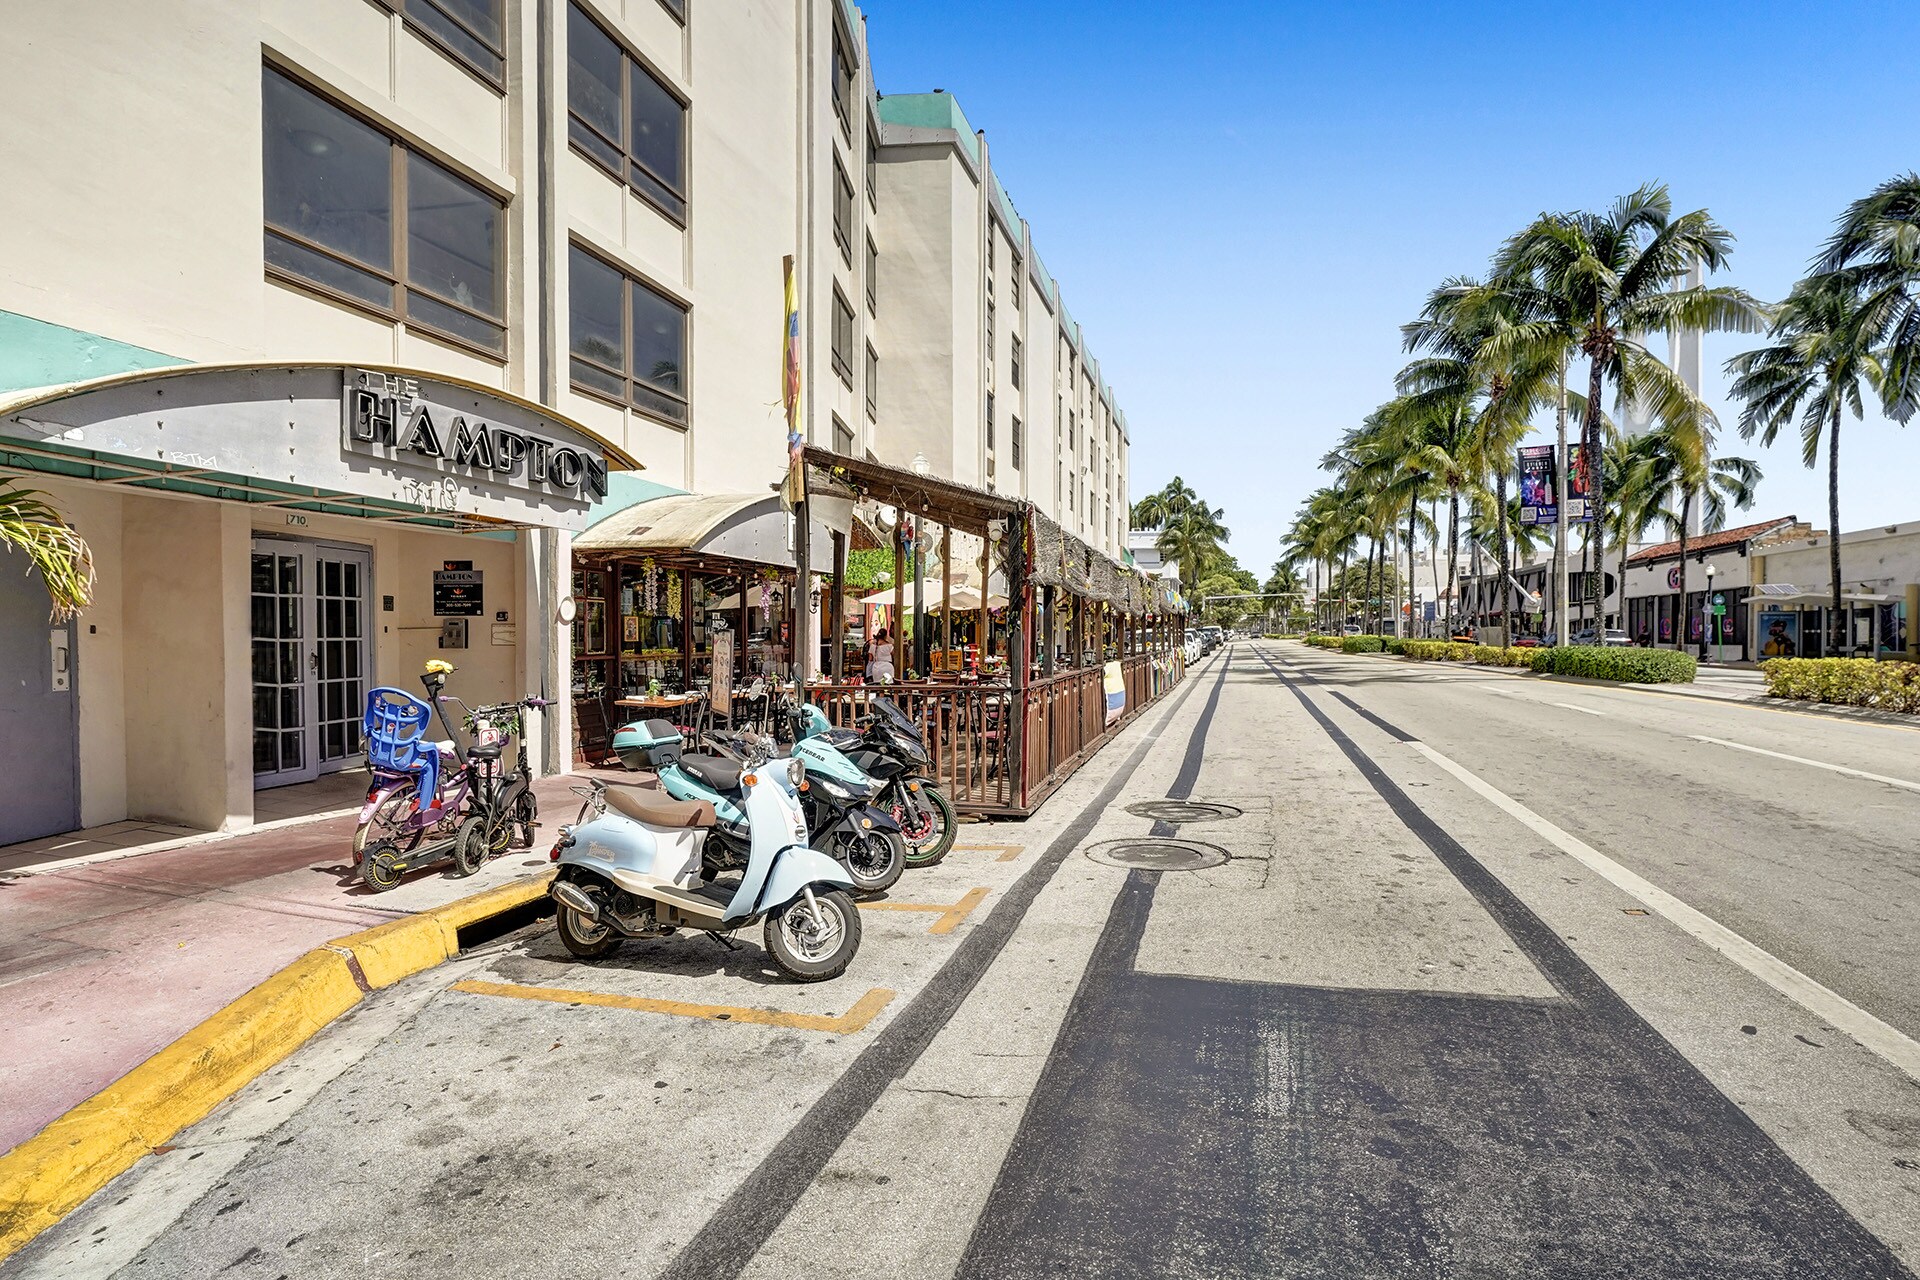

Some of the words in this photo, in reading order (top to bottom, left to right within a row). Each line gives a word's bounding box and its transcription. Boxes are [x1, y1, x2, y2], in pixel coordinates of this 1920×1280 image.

[357, 368, 419, 398] THE
[351, 388, 608, 497] HAMPTON
[290, 514, 306, 525] 710
[799, 746, 826, 762] ICEBEAR
